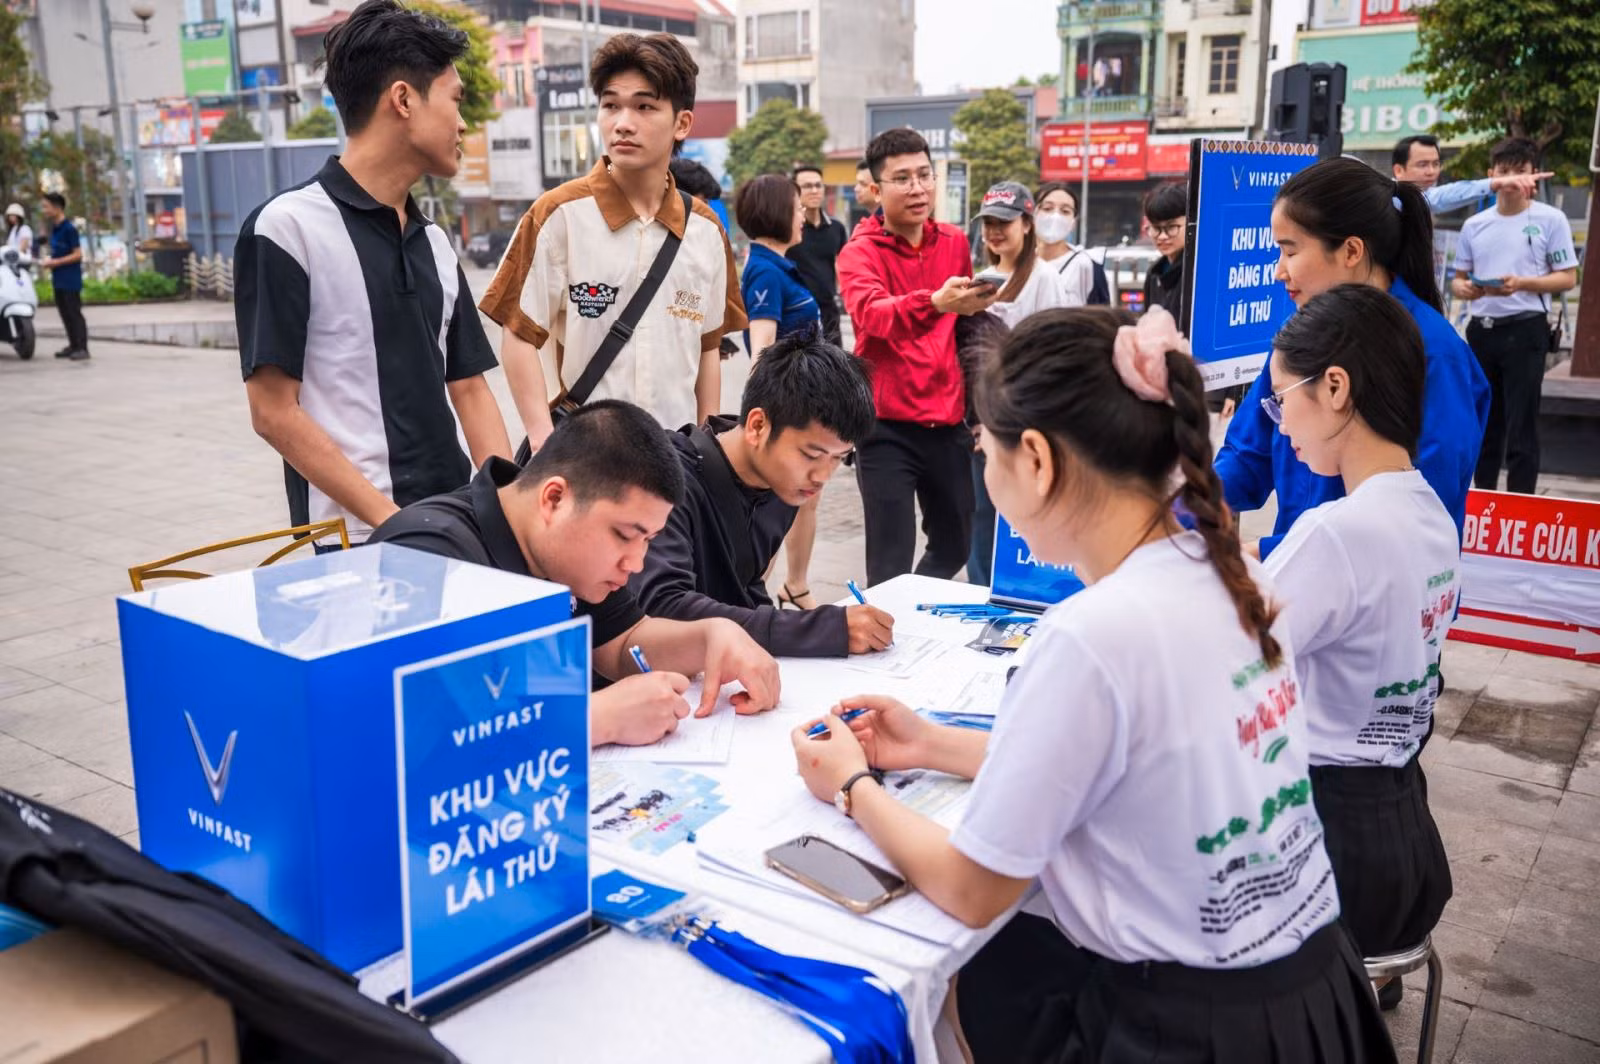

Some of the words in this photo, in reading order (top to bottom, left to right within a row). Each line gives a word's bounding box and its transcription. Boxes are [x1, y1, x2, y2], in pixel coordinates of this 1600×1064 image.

[1249, 171, 1292, 187] VINFAST
[1231, 227, 1257, 251] KHU
[1228, 262, 1261, 290] ĐĂNG
[1262, 258, 1278, 286] KÝ
[1229, 299, 1248, 327] LÁI
[1249, 294, 1272, 324] THỬ
[1462, 502, 1495, 552] ĐỂ
[1495, 518, 1527, 556] XE
[1531, 512, 1577, 563] CỦA
[1583, 528, 1600, 566] K
[452, 701, 544, 747] VINFAST
[430, 774, 494, 826] KHU
[503, 747, 571, 796] VỰC
[188, 807, 252, 852] VINFAST
[427, 811, 526, 876] ĐĂNG
[533, 784, 571, 831] KÝ
[446, 866, 496, 916] LÁI
[503, 830, 560, 889] THỬ
